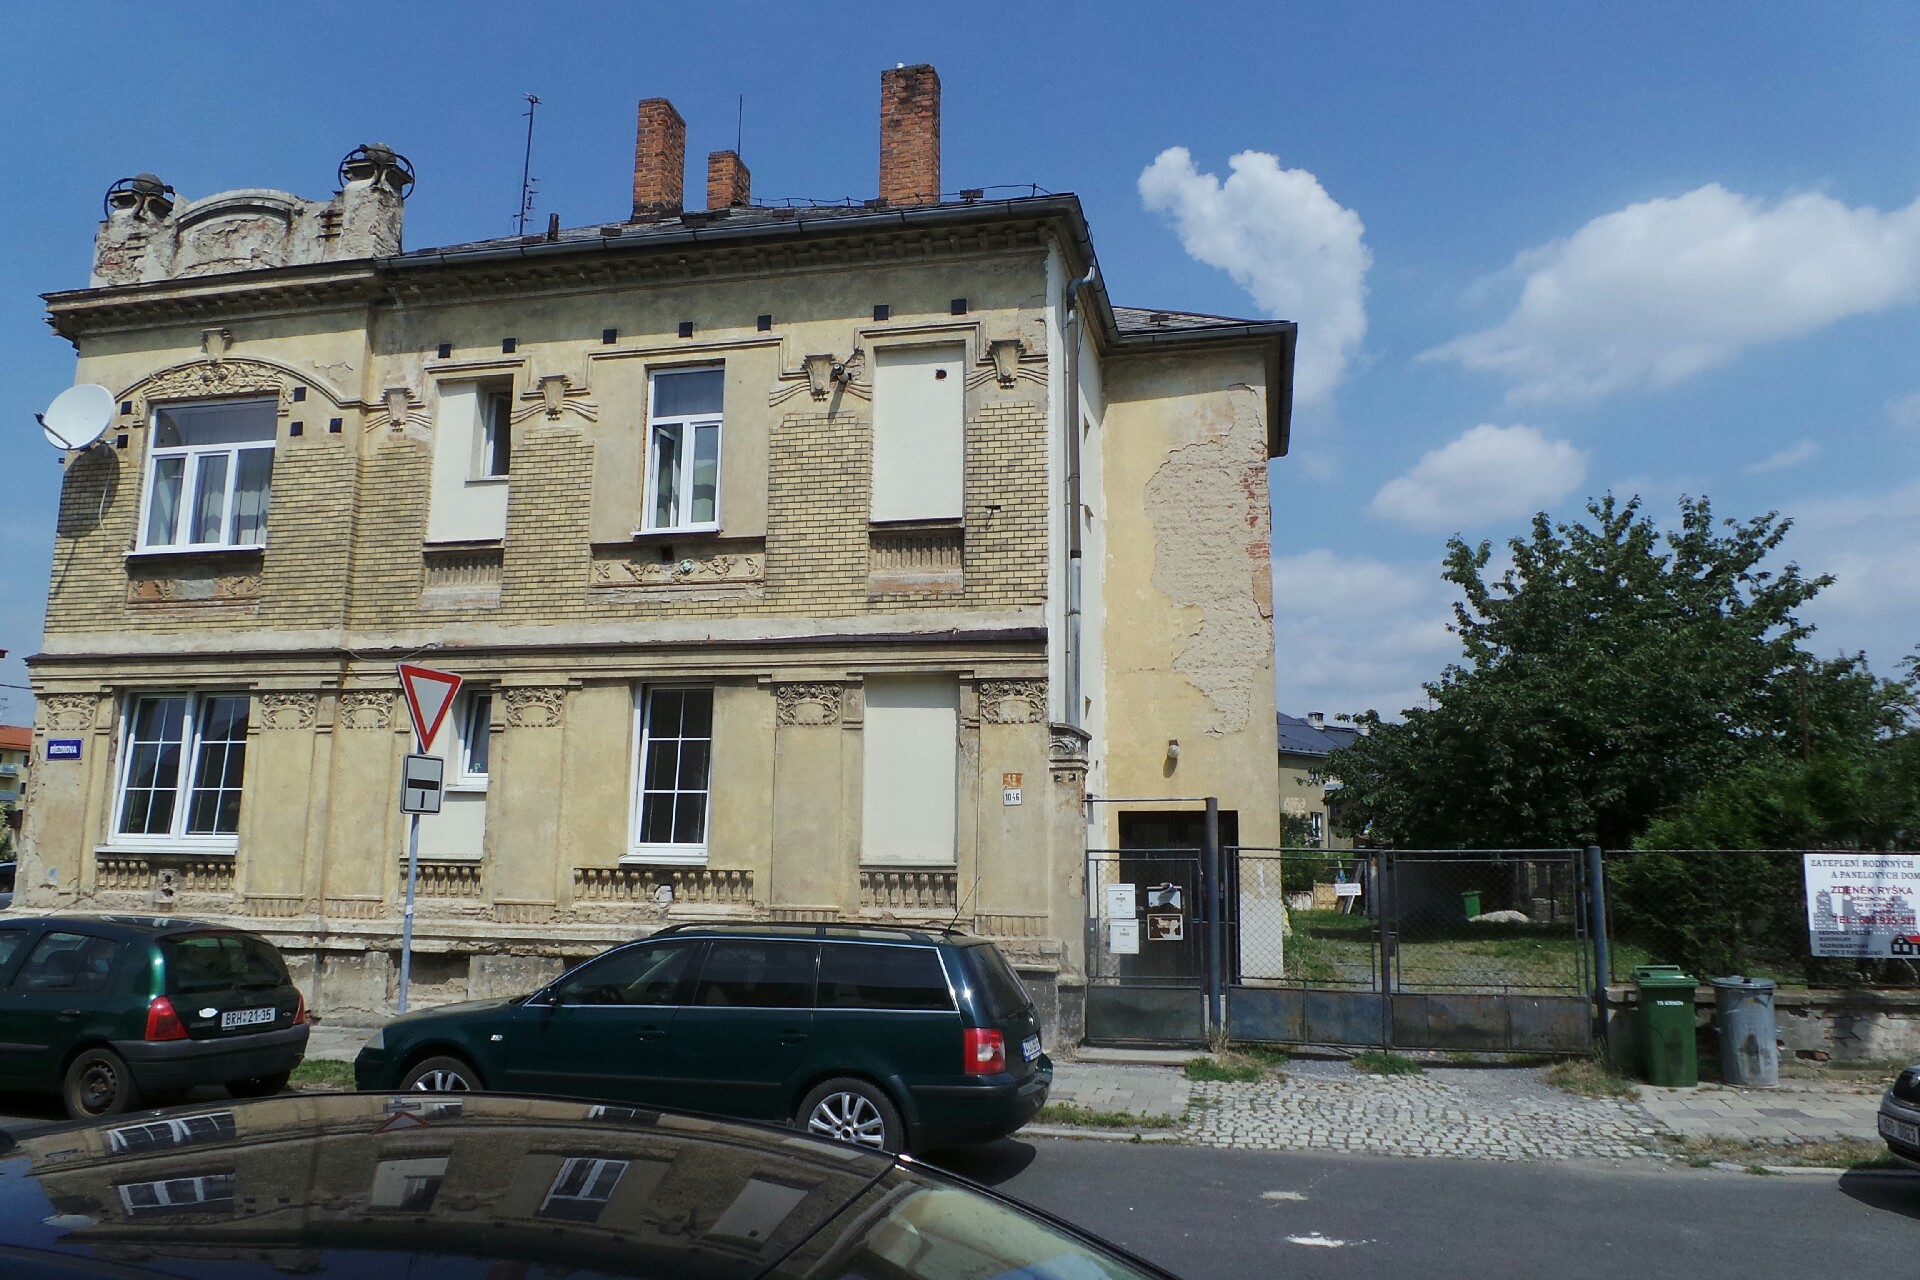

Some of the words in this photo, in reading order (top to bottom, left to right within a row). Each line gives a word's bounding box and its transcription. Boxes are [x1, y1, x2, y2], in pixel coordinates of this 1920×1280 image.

[1005, 793, 1020, 801] 1046
[1811, 858, 1860, 867] ZATEPLENÍ
[1862, 859, 1914, 869] RODINNÝCH
[1831, 871, 1838, 879] A
[1840, 871, 1898, 880] PANELOVÝCH
[1831, 885, 1875, 895] ZDENĚK
[1877, 885, 1914, 895] RYŠKA
[226, 1013, 242, 1025] BRH
[248, 1009, 272, 1022] 21-35
